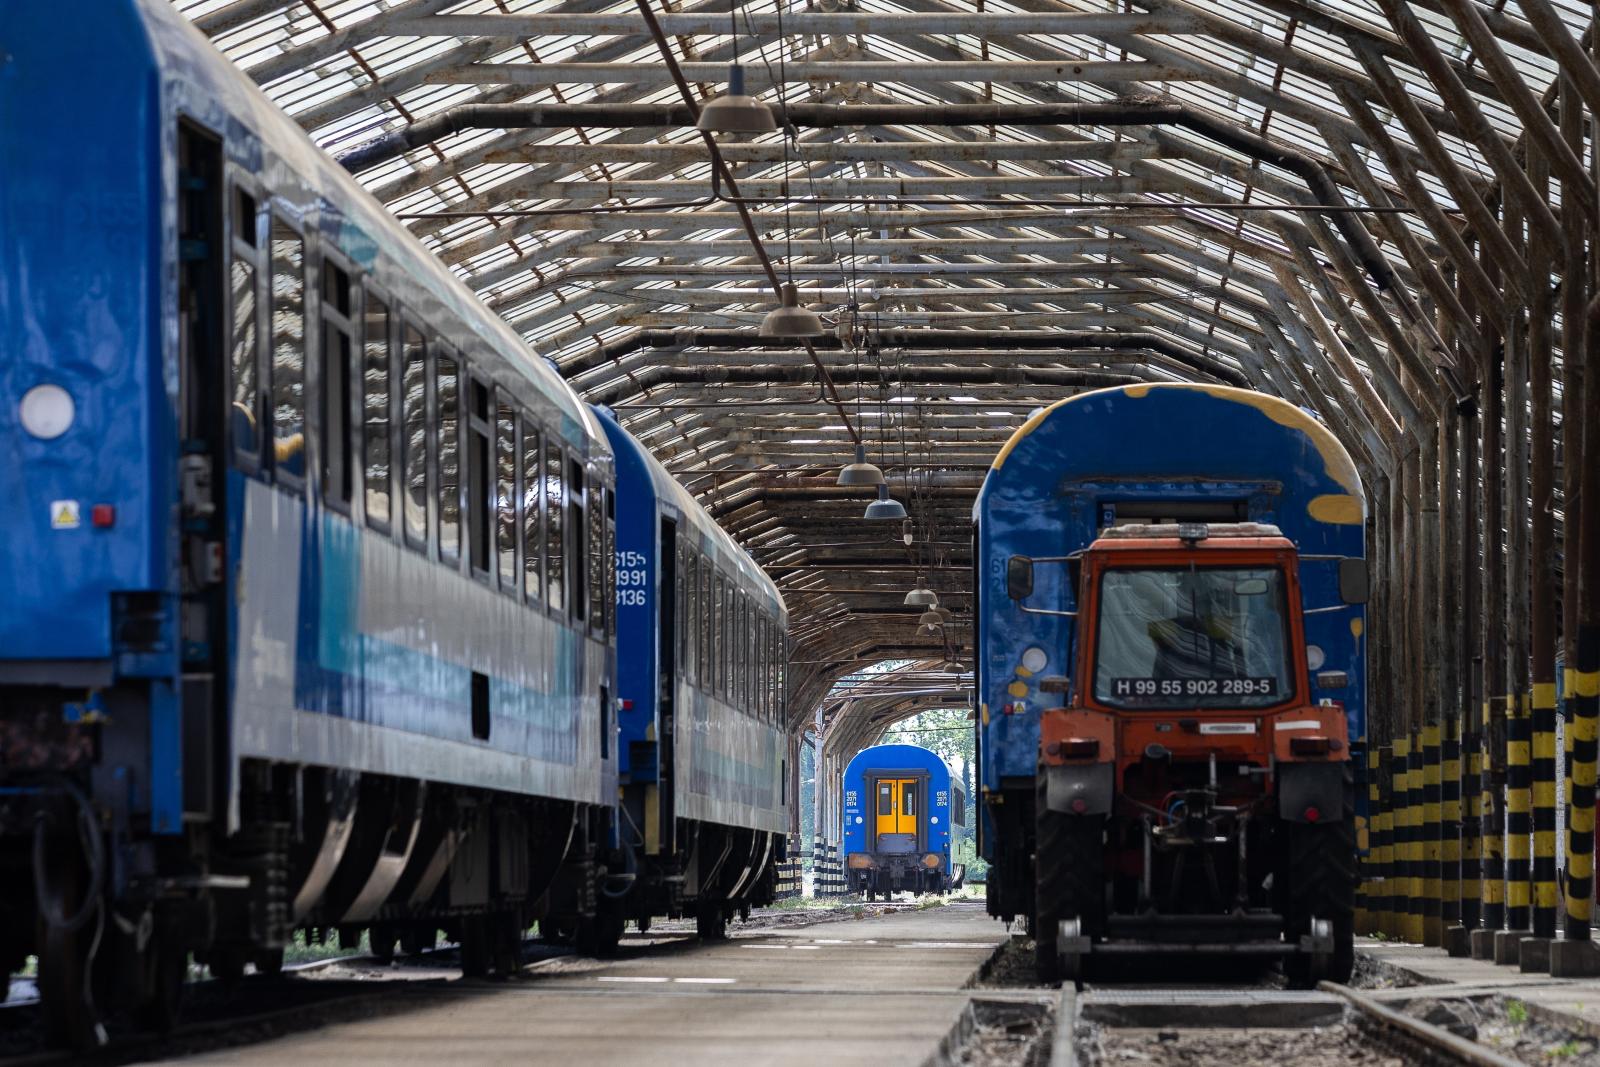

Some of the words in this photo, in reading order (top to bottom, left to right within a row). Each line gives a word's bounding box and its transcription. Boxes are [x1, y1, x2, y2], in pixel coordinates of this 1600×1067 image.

[616, 570, 646, 586] 1991
[1117, 680, 1130, 695] H
[1135, 680, 1157, 695] 99
[1161, 680, 1182, 695] 55
[1187, 680, 1218, 695] 902
[1222, 679, 1270, 694] 289-5
